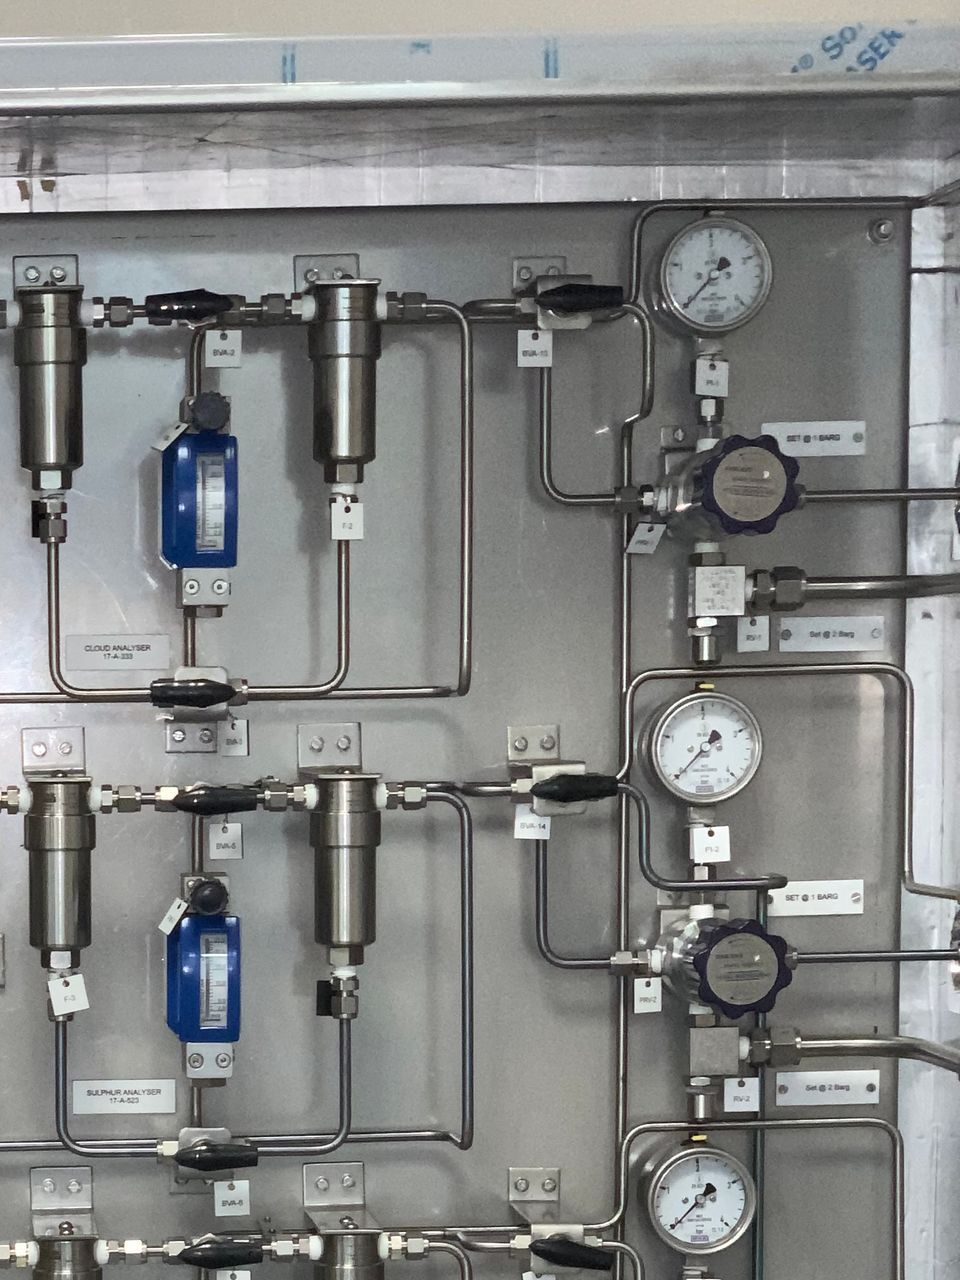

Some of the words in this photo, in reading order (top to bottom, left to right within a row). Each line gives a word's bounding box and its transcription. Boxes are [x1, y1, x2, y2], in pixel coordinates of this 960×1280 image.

[786, 434, 800, 442] SET
[809, 630, 821, 638] Set
[838, 630, 855, 639] Barg
[112, 644, 151, 652] ANALYSER
[519, 822, 546, 830] BVA-14
[801, 894, 809, 902] @
[123, 1088, 162, 1096] ANALYSER
[818, 1084, 826, 1092] @
[834, 1084, 850, 1092] Barg
